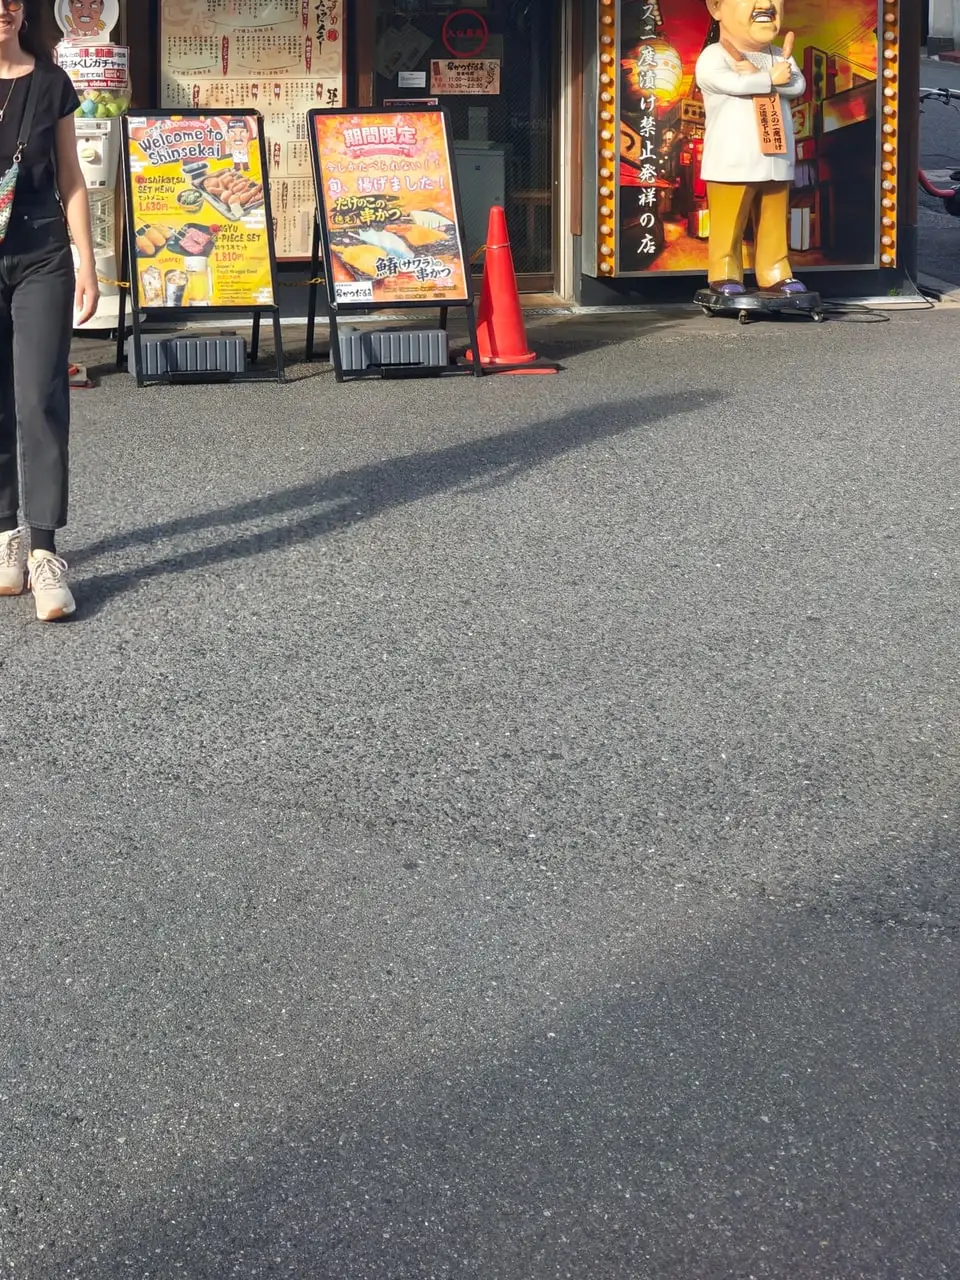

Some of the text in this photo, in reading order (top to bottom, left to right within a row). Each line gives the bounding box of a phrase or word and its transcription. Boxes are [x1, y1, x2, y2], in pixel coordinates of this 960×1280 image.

[138, 128, 223, 153] Welcome to
[343, 126, 417, 147] 期間限定
[149, 143, 220, 165] Shinsekai
[138, 185, 175, 194] SET MENU
[335, 197, 386, 211] たけのこの
[359, 208, 402, 225] 串かつ
[246, 234, 261, 242] SET
[416, 268, 452, 281] 串かつ
